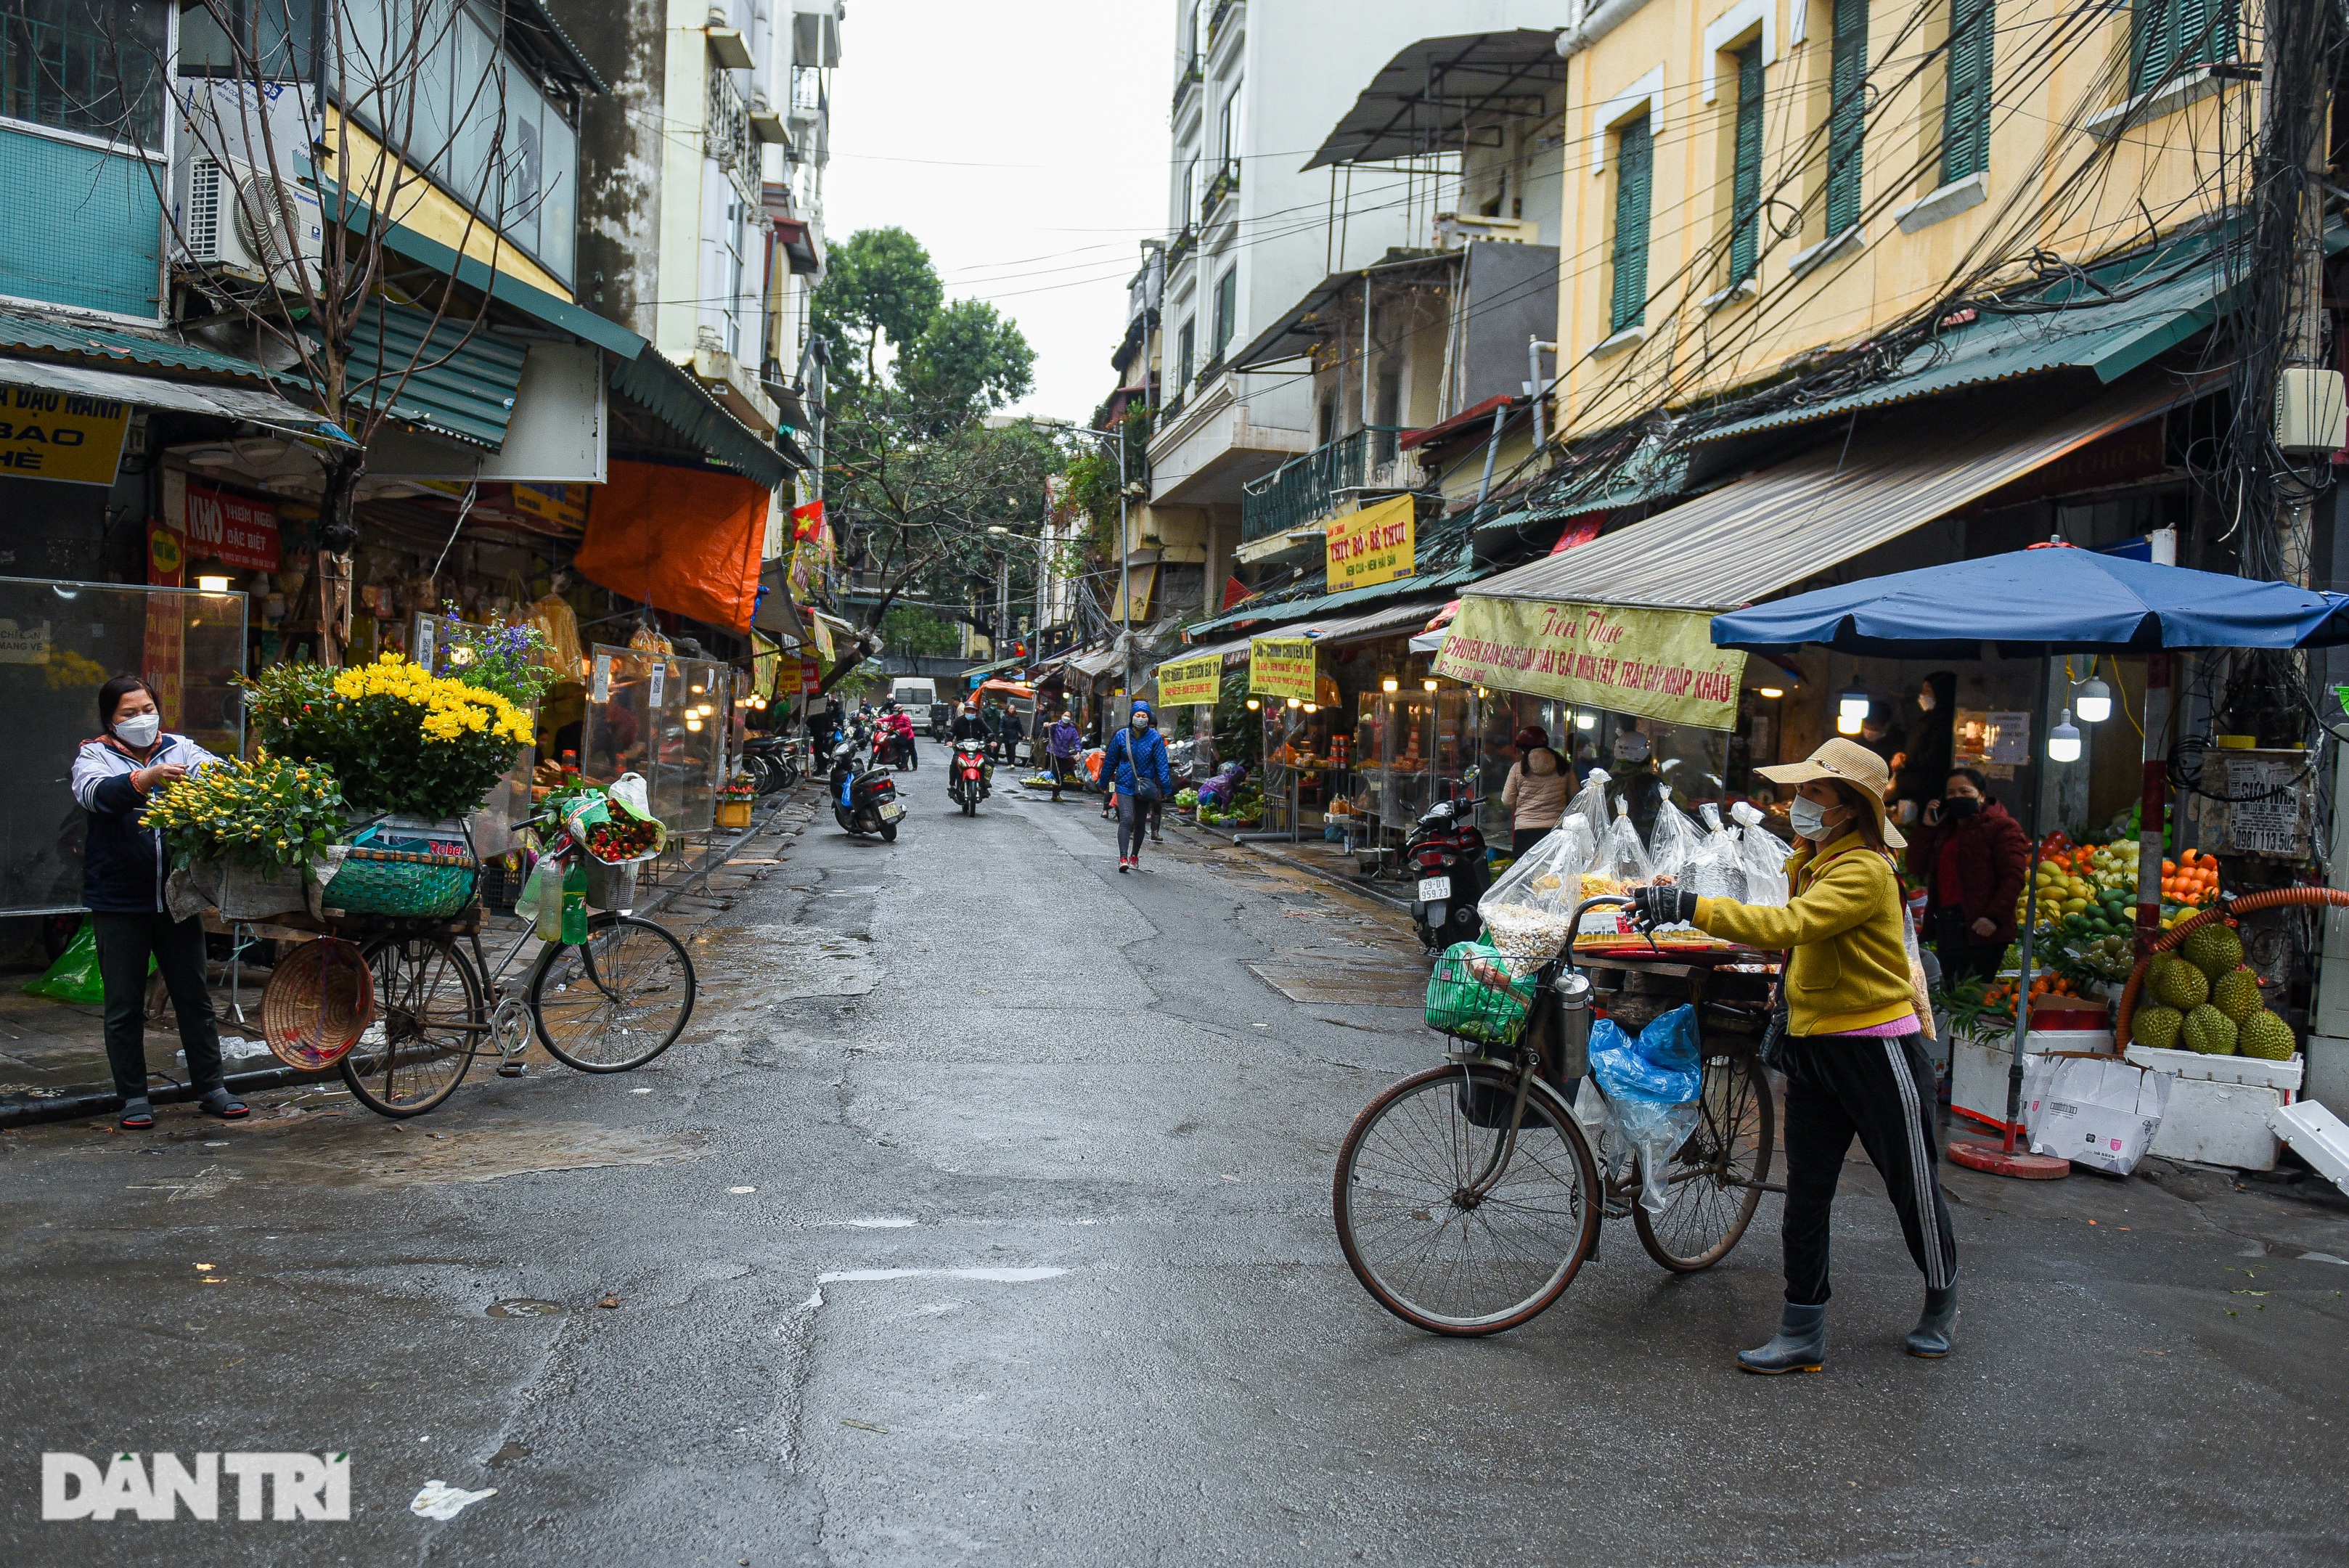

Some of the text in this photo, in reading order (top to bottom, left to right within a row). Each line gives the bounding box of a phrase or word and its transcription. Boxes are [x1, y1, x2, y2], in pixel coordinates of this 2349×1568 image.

[294, 191, 319, 207] Panasonic
[248, 532, 266, 552] BIỆT
[1330, 538, 1349, 566] THỊT
[1352, 528, 1364, 558] BÒ
[1383, 520, 1406, 548] THUI
[1443, 635, 1484, 663] CHUYÊN
[1481, 639, 1502, 666] BÁN
[1618, 657, 1645, 690] TRÁI
[1661, 662, 1693, 702] NHẬP
[1693, 661, 1731, 703] KHẨU
[1450, 664, 1462, 676] 17
[2236, 830, 2296, 851] 0981 113 502
[1421, 888, 1448, 899] 959.23
